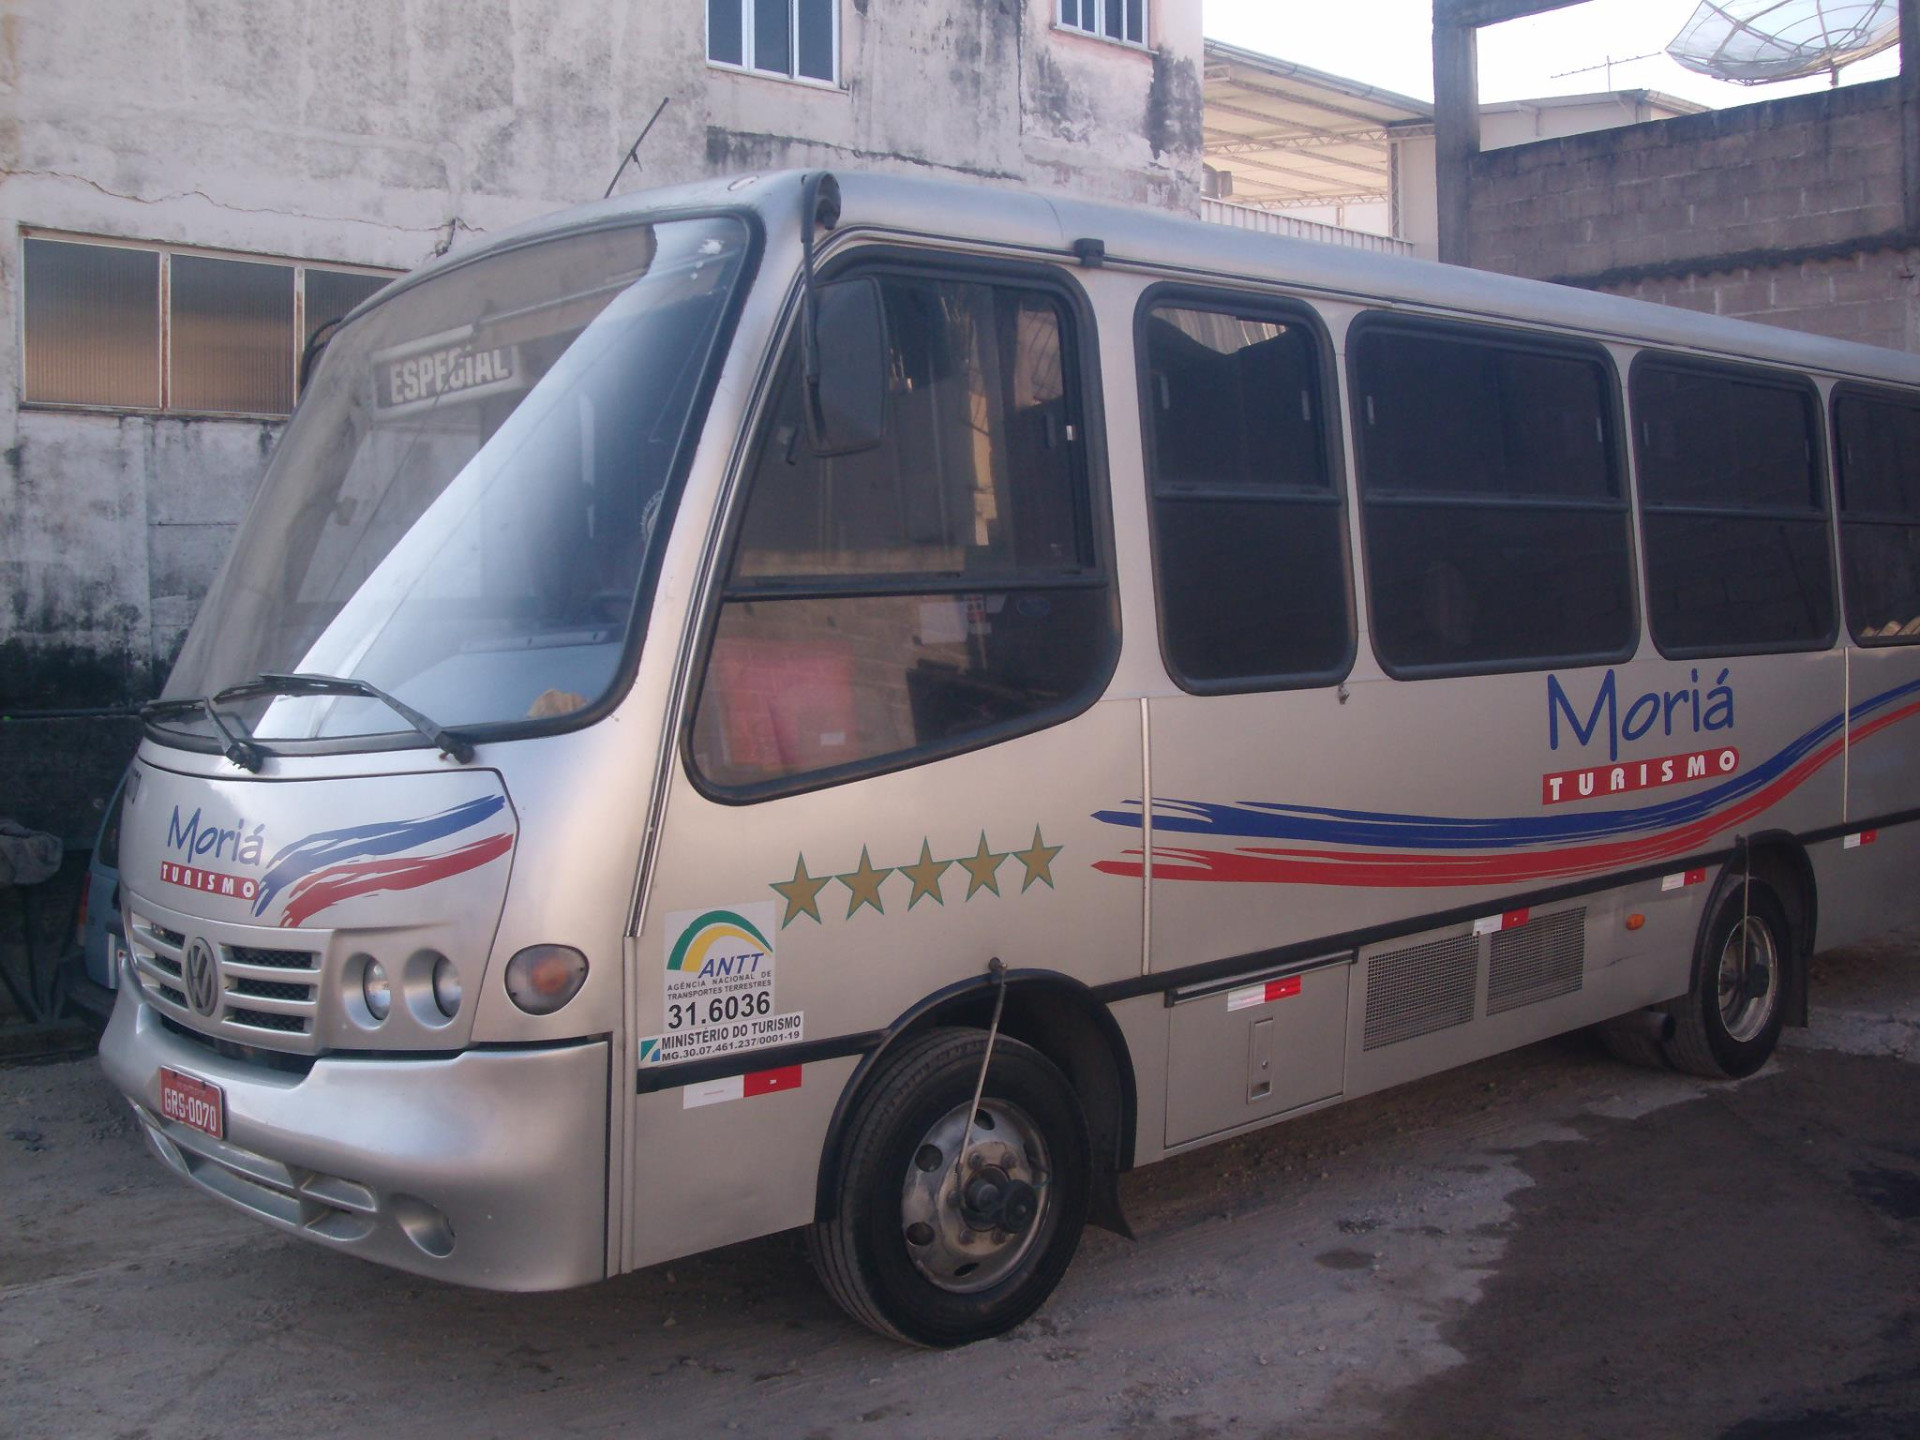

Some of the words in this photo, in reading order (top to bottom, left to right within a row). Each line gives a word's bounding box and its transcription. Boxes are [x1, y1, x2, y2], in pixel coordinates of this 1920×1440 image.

[390, 349, 509, 403] ESPECIAL
[1547, 667, 1734, 762] Moriá
[1549, 750, 1735, 801] TURISMO
[167, 804, 266, 866] Moriá
[162, 864, 255, 898] TURISMO
[667, 980, 706, 991] AGÊNCIA
[712, 973, 755, 985] NACIONAL
[761, 970, 772, 978] DE
[697, 952, 765, 979] ANTT
[667, 986, 723, 1000] TRANSPORTES
[724, 979, 772, 992] TERRESTRES
[668, 991, 770, 1029] 31.6036
[661, 1027, 729, 1050] MINISTÉRIO
[732, 1024, 748, 1038] DO
[751, 1015, 801, 1034] TURISMO
[164, 1087, 217, 1132] GRS-0070
